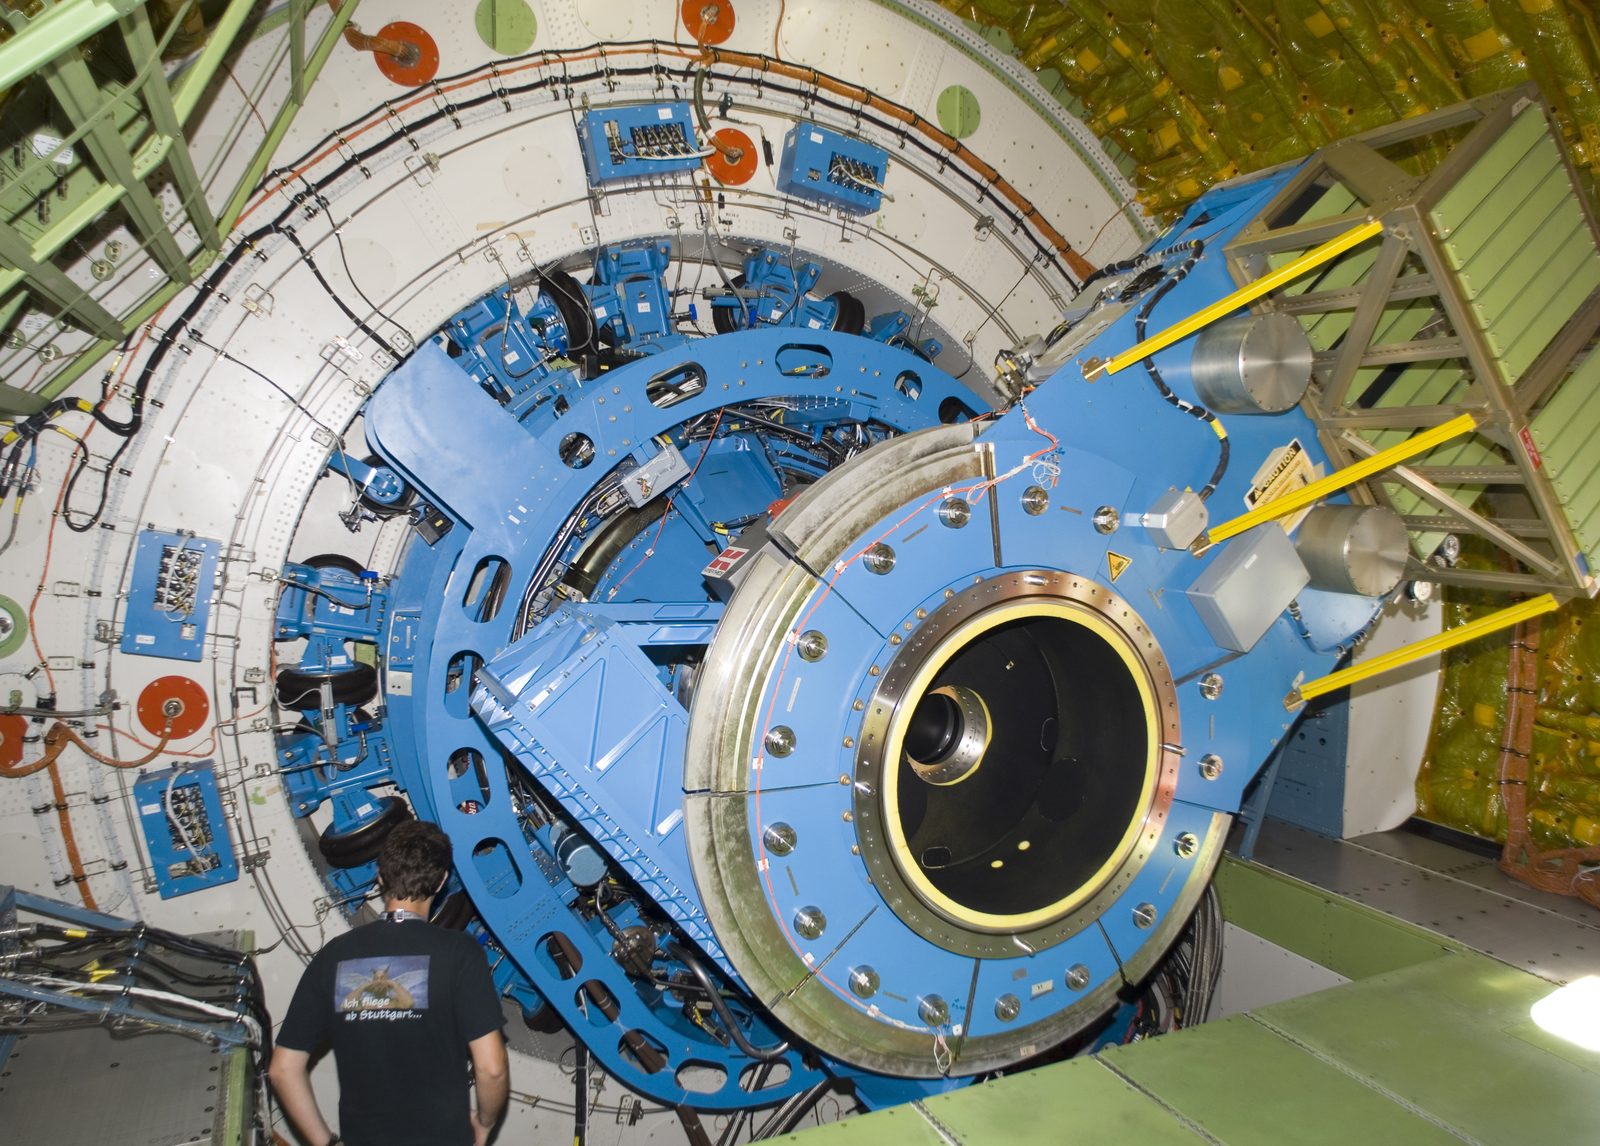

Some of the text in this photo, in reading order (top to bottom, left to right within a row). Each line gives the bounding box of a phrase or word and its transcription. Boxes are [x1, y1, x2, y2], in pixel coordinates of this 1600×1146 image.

[344, 996, 391, 1008] Ich fliege
[345, 1010, 422, 1021] ab Stuttgart...
